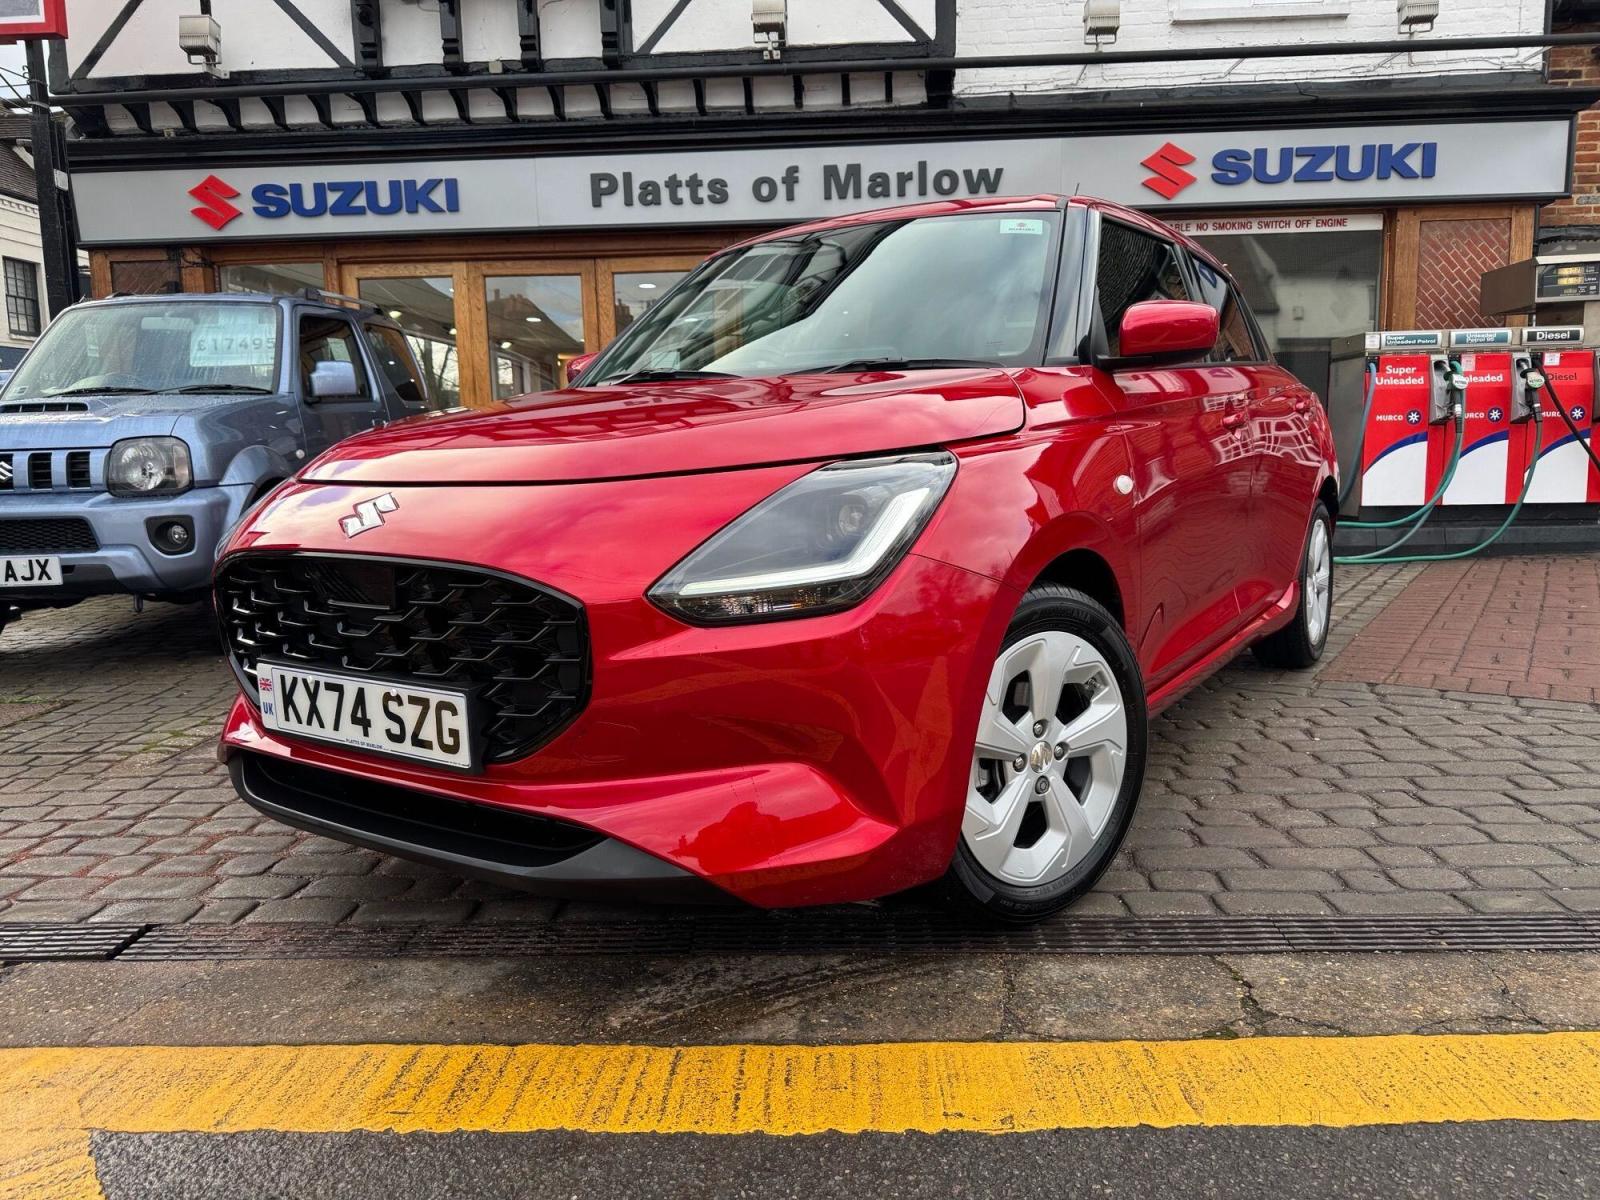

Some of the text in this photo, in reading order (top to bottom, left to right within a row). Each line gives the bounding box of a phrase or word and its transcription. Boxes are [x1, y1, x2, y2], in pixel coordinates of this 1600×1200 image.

[1211, 142, 1437, 186] SUZUKI
[589, 160, 1004, 207] Platts of Marlow
[251, 177, 459, 218] SUZUKI
[1196, 222, 1208, 232] NO
[1212, 220, 1252, 231] SMOKING
[1257, 219, 1291, 230] SWITCH
[1295, 218, 1312, 229] OFF
[1316, 217, 1348, 228] ENGINE
[1536, 330, 1570, 340] Diesel
[1385, 365, 1416, 376] Super
[1546, 372, 1577, 381] Diesel
[1375, 376, 1424, 385] Unleaded
[5, 559, 52, 582] AJX
[263, 702, 274, 715] UK
[280, 674, 461, 755] KX74 SZG
